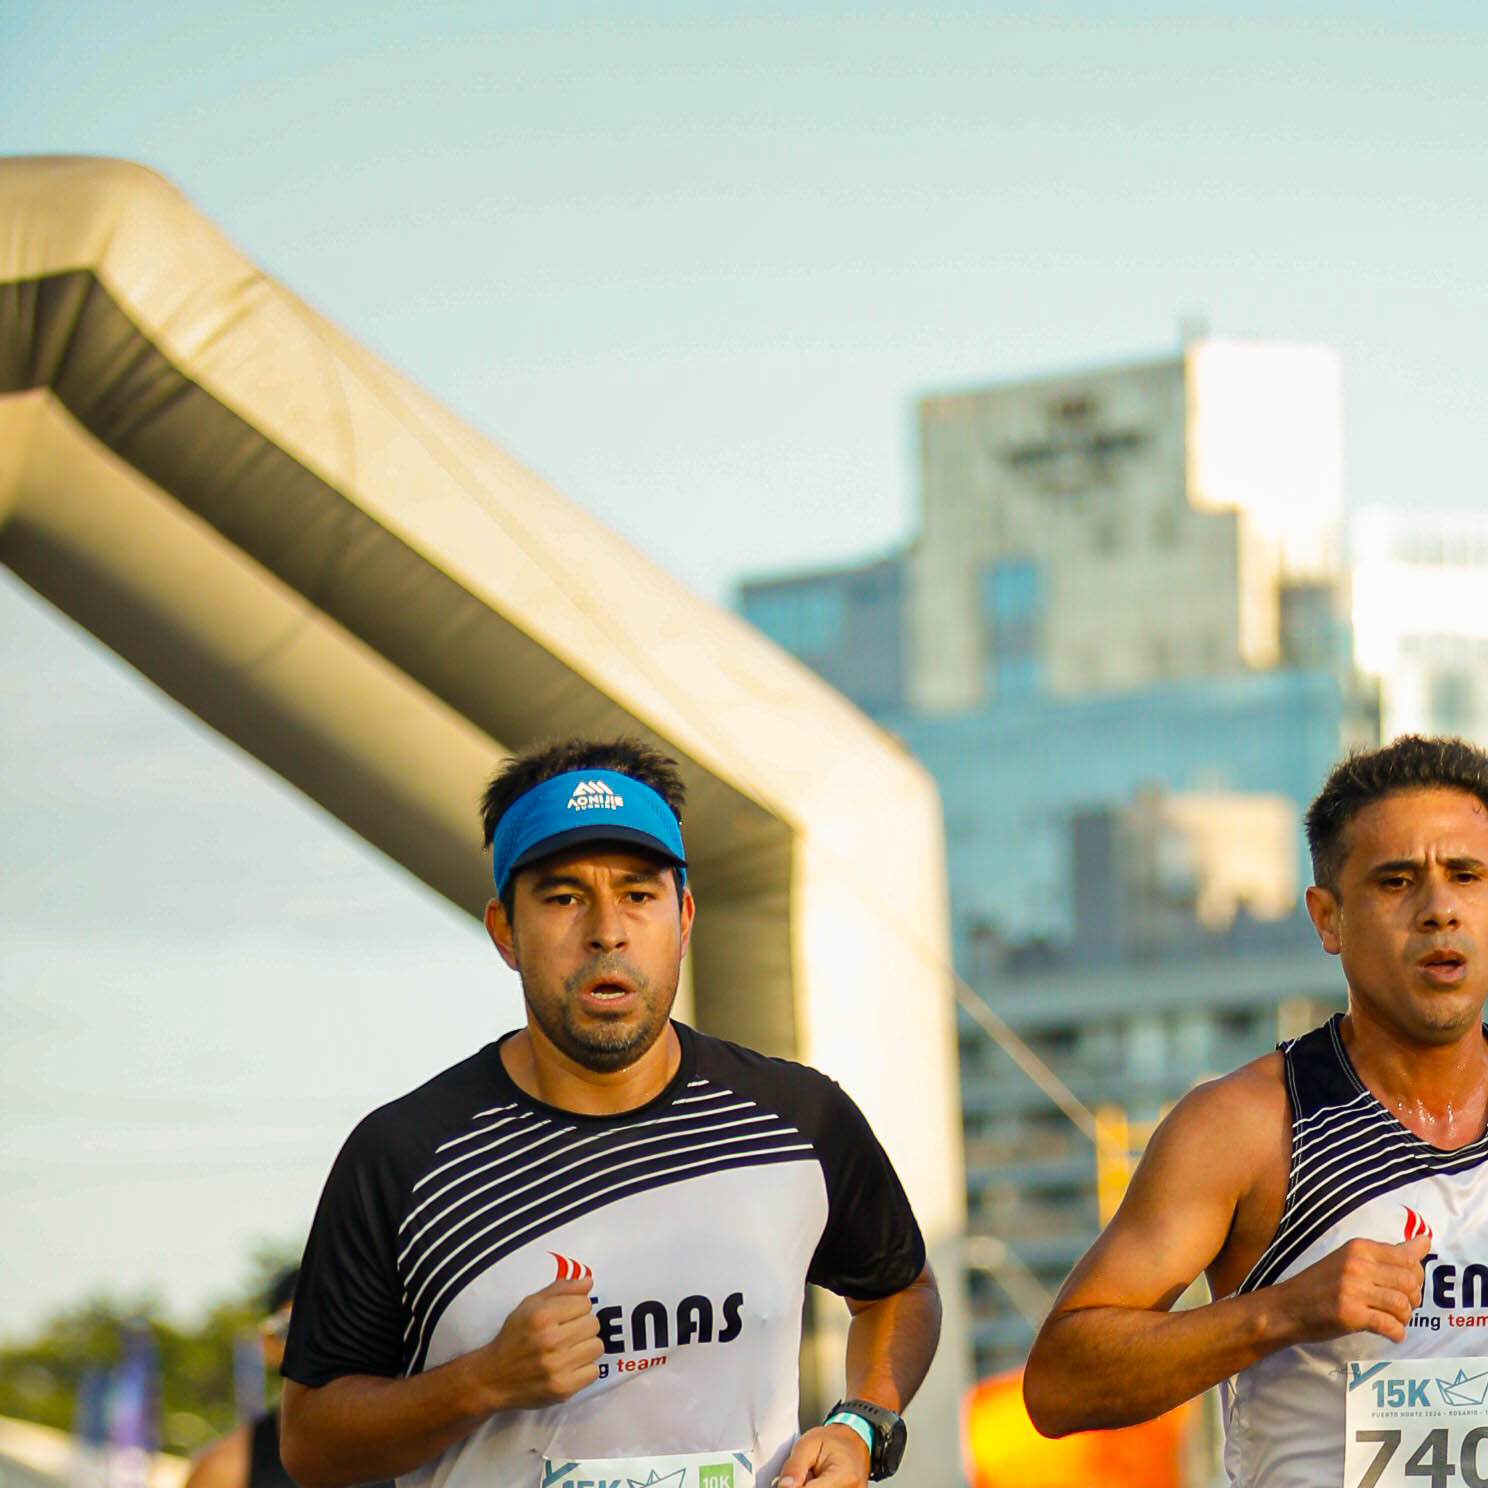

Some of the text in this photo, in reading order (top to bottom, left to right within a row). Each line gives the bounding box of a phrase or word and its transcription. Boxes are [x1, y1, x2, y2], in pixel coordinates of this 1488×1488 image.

[590, 1292, 744, 1354] ENAS
[617, 1355, 667, 1372] team
[1372, 1379, 1431, 1408] 15K
